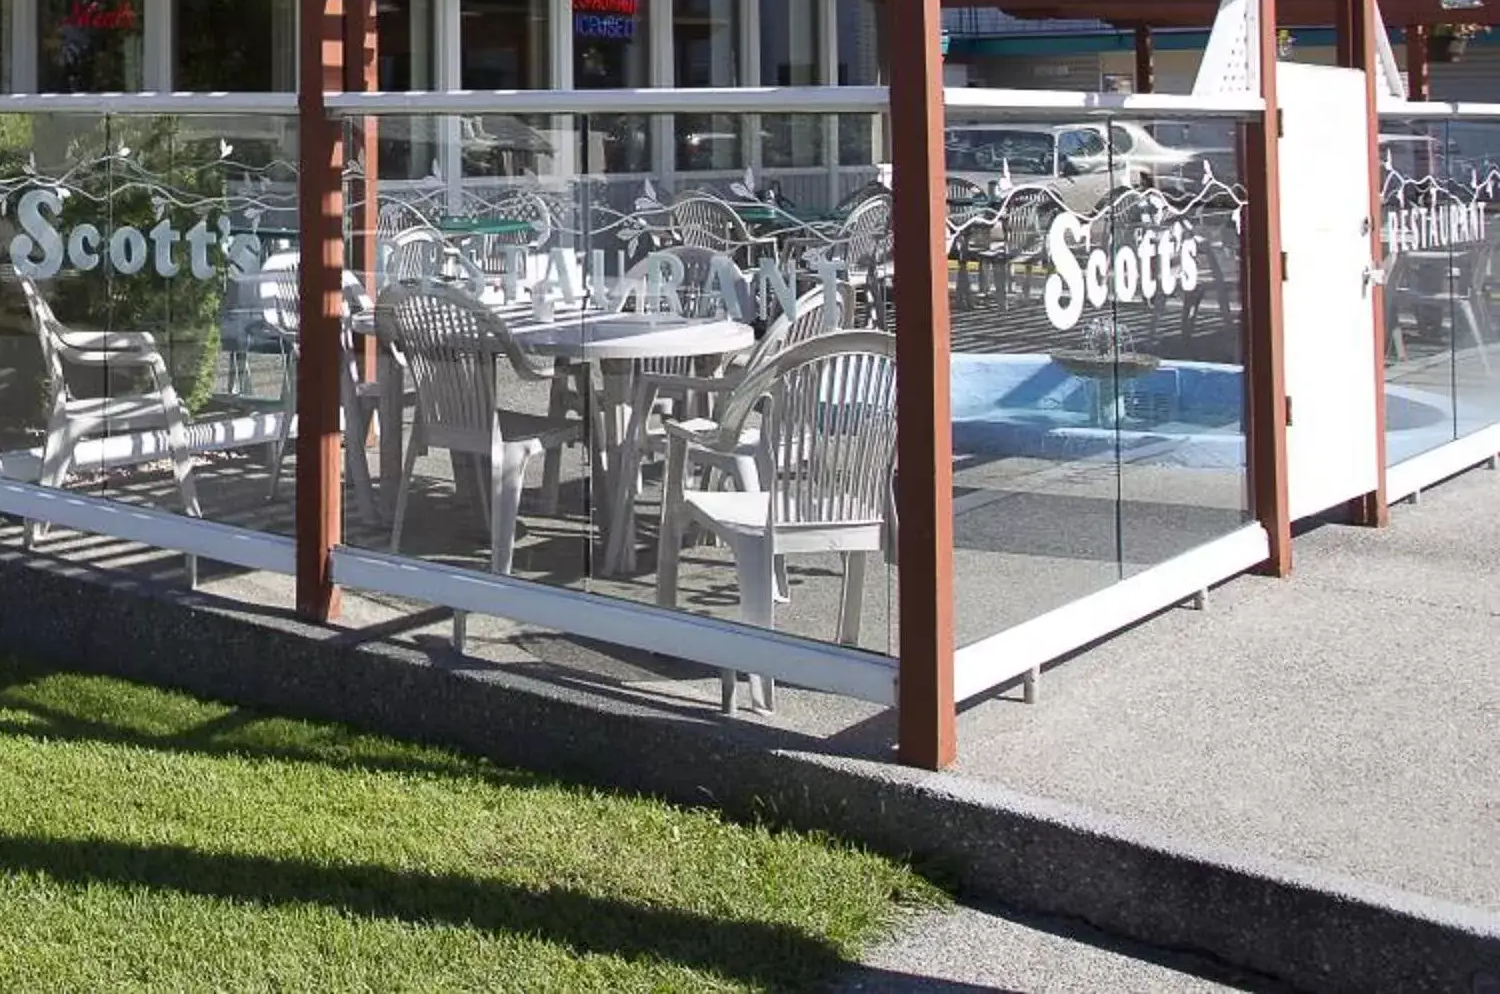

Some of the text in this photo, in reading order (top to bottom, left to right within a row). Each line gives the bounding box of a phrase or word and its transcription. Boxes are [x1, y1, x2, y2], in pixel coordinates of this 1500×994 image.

[9, 189, 262, 282] Scott's
[1045, 212, 1198, 331] Scott's
[1387, 201, 1487, 253] RESTAURANT
